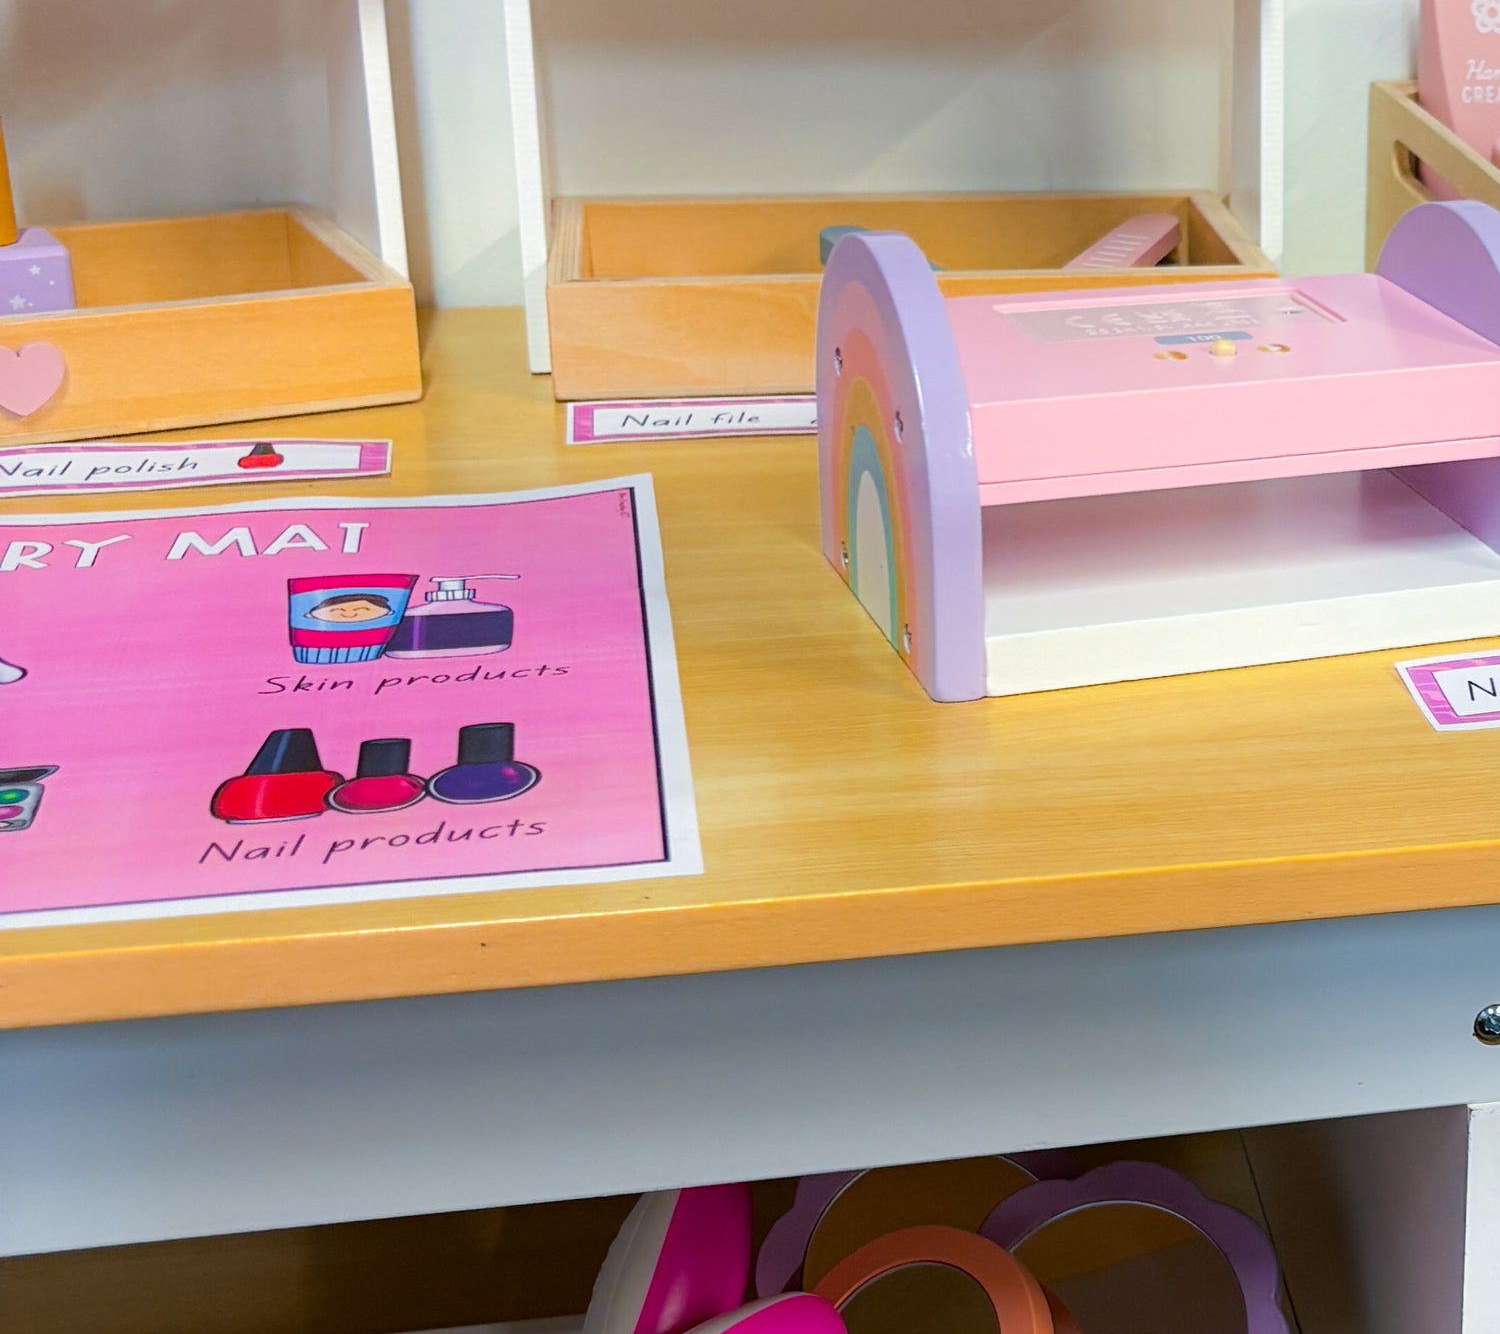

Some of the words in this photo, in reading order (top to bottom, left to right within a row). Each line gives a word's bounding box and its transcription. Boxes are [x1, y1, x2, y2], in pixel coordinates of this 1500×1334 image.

[621, 413, 693, 428] Nail
[710, 411, 761, 424] file
[85, 457, 199, 481] polish
[165, 522, 370, 561] MAT
[257, 674, 354, 695] Skin
[374, 664, 571, 695] products
[198, 834, 307, 865] Nail
[322, 819, 547, 865] products
